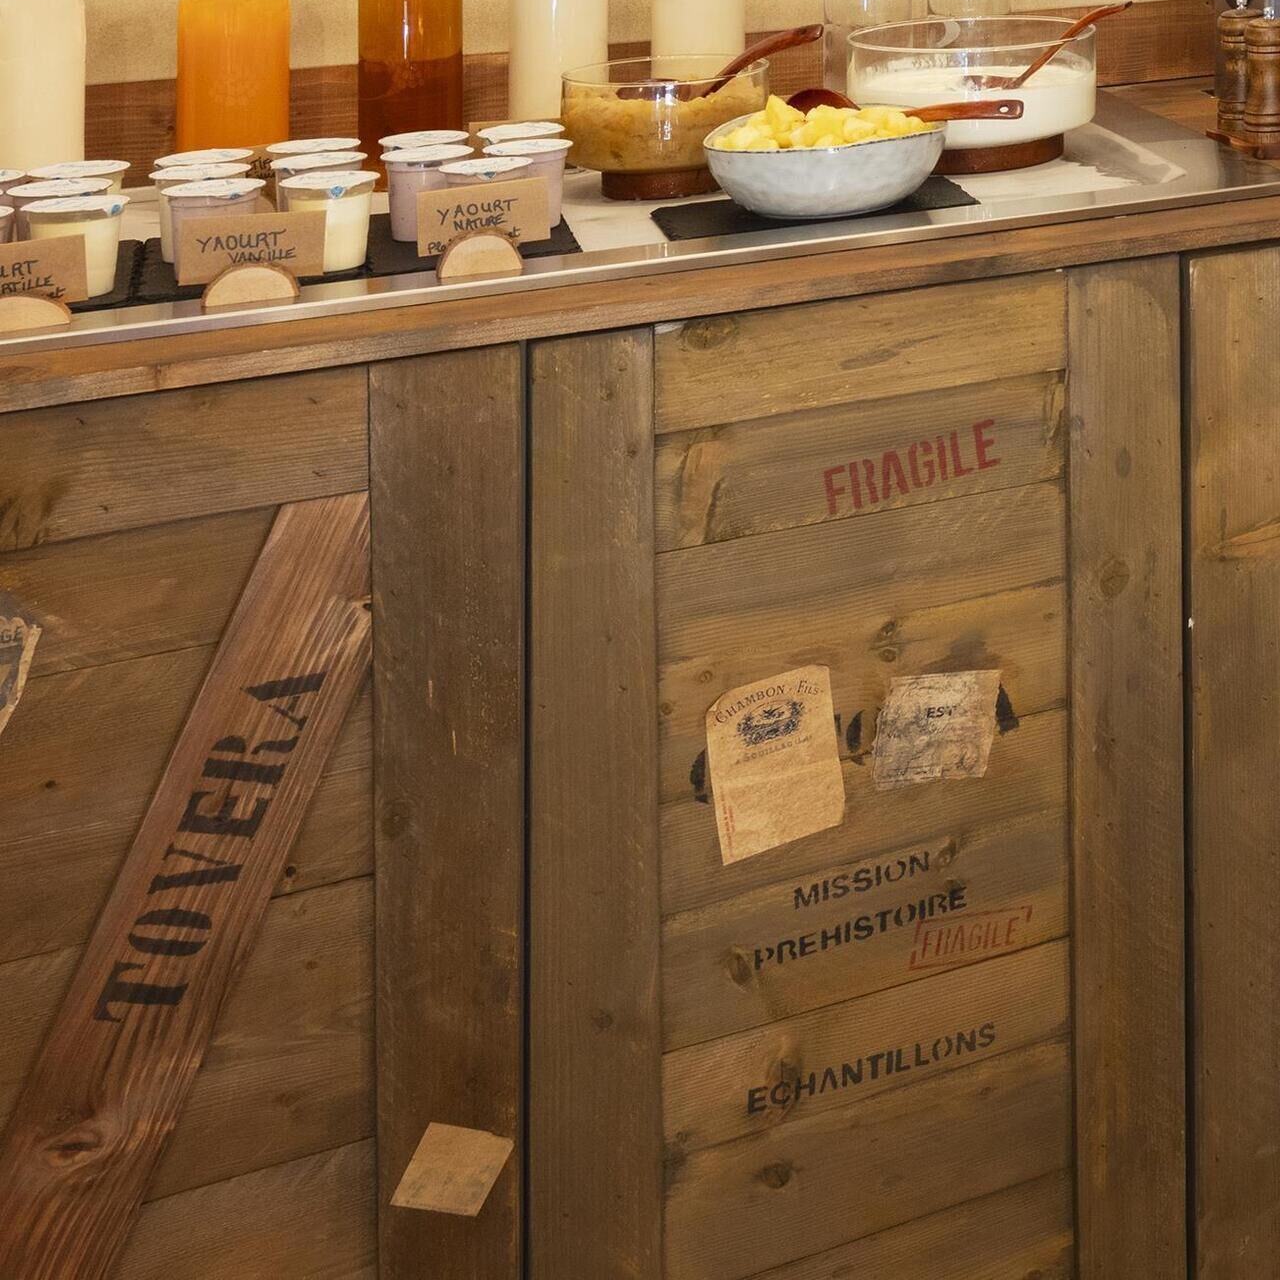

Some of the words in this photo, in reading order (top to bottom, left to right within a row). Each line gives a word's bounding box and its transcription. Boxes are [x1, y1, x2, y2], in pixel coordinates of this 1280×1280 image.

[436, 198, 519, 226] YAOURT
[453, 213, 508, 232] NATURE
[196, 228, 287, 254] YAOURT
[823, 419, 1001, 516] FRAGILE
[715, 685, 785, 724] CHAMBON
[94, 671, 327, 1024] TOVERA
[793, 850, 931, 910] MISSION
[754, 884, 968, 970] PREHISTOIRE
[921, 916, 1021, 959] FRAGILE
[746, 1021, 997, 1116] ECHANTILLONS
